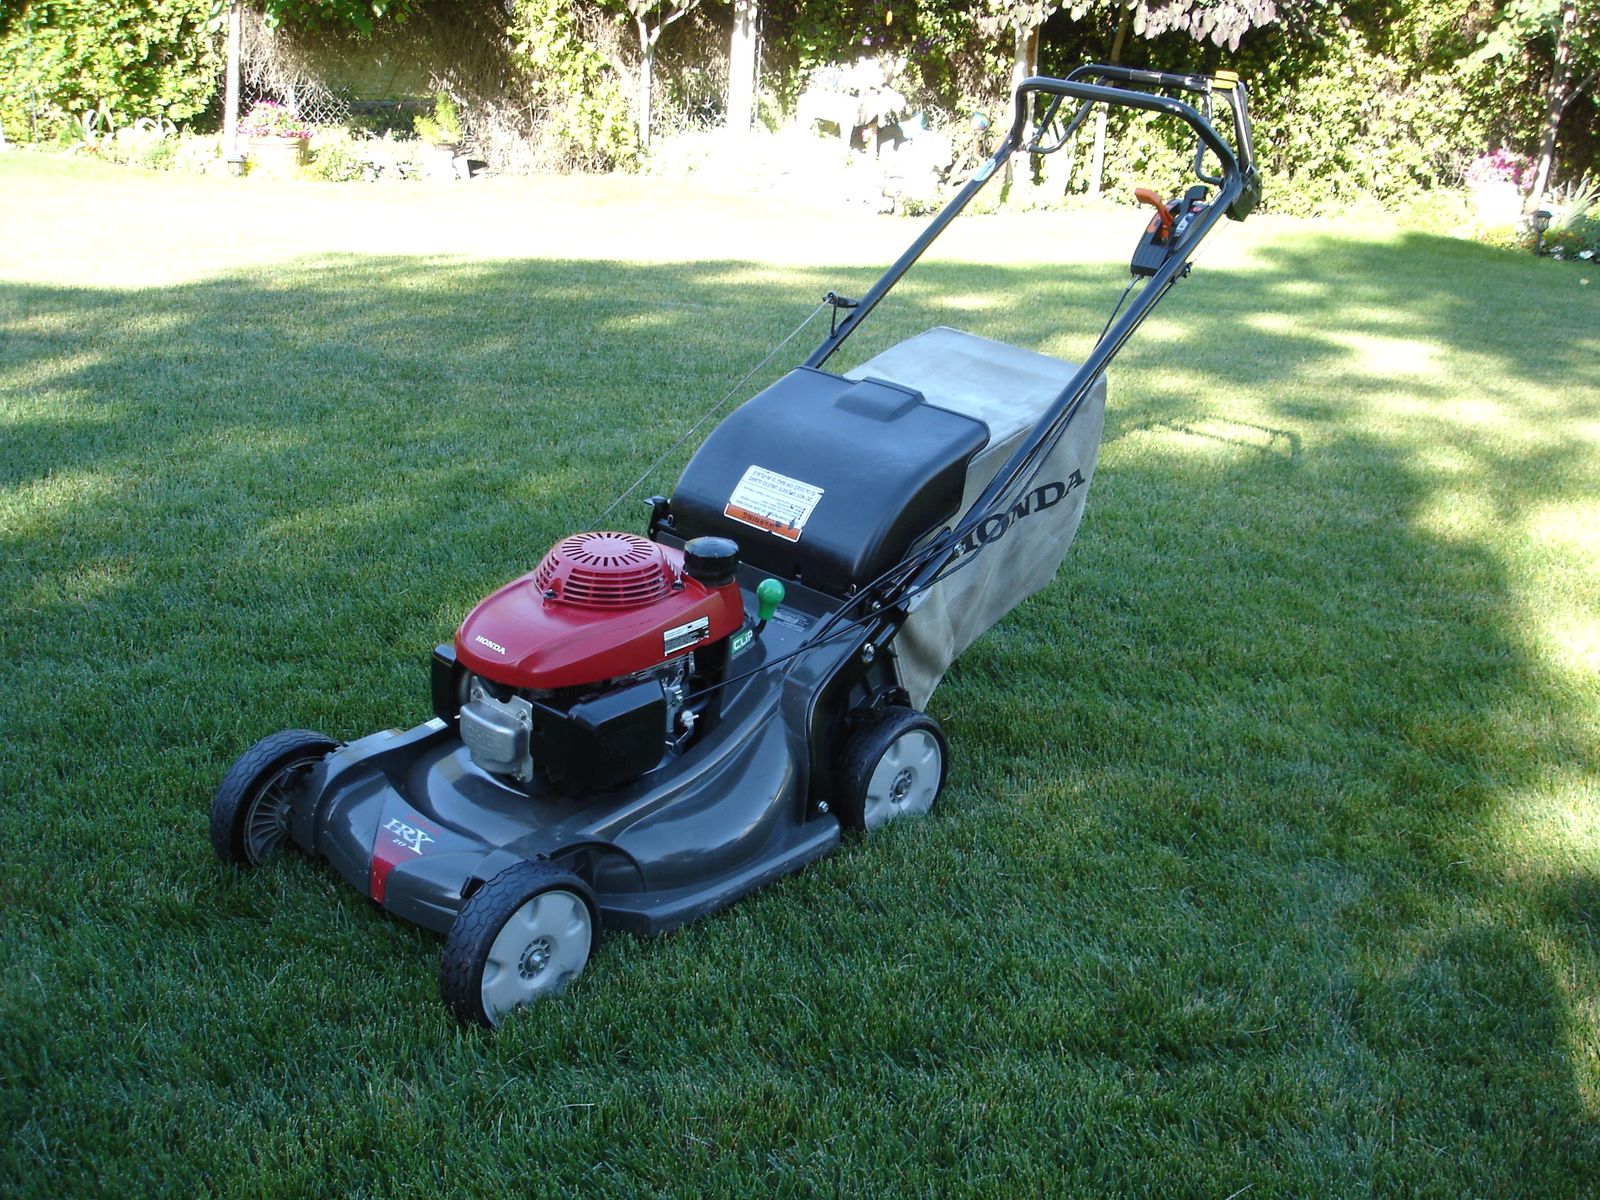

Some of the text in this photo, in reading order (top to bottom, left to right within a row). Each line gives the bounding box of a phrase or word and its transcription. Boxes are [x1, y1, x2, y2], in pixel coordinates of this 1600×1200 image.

[742, 512, 776, 529] WARNING
[475, 635, 505, 655] HONDA
[383, 817, 436, 855] HRX
